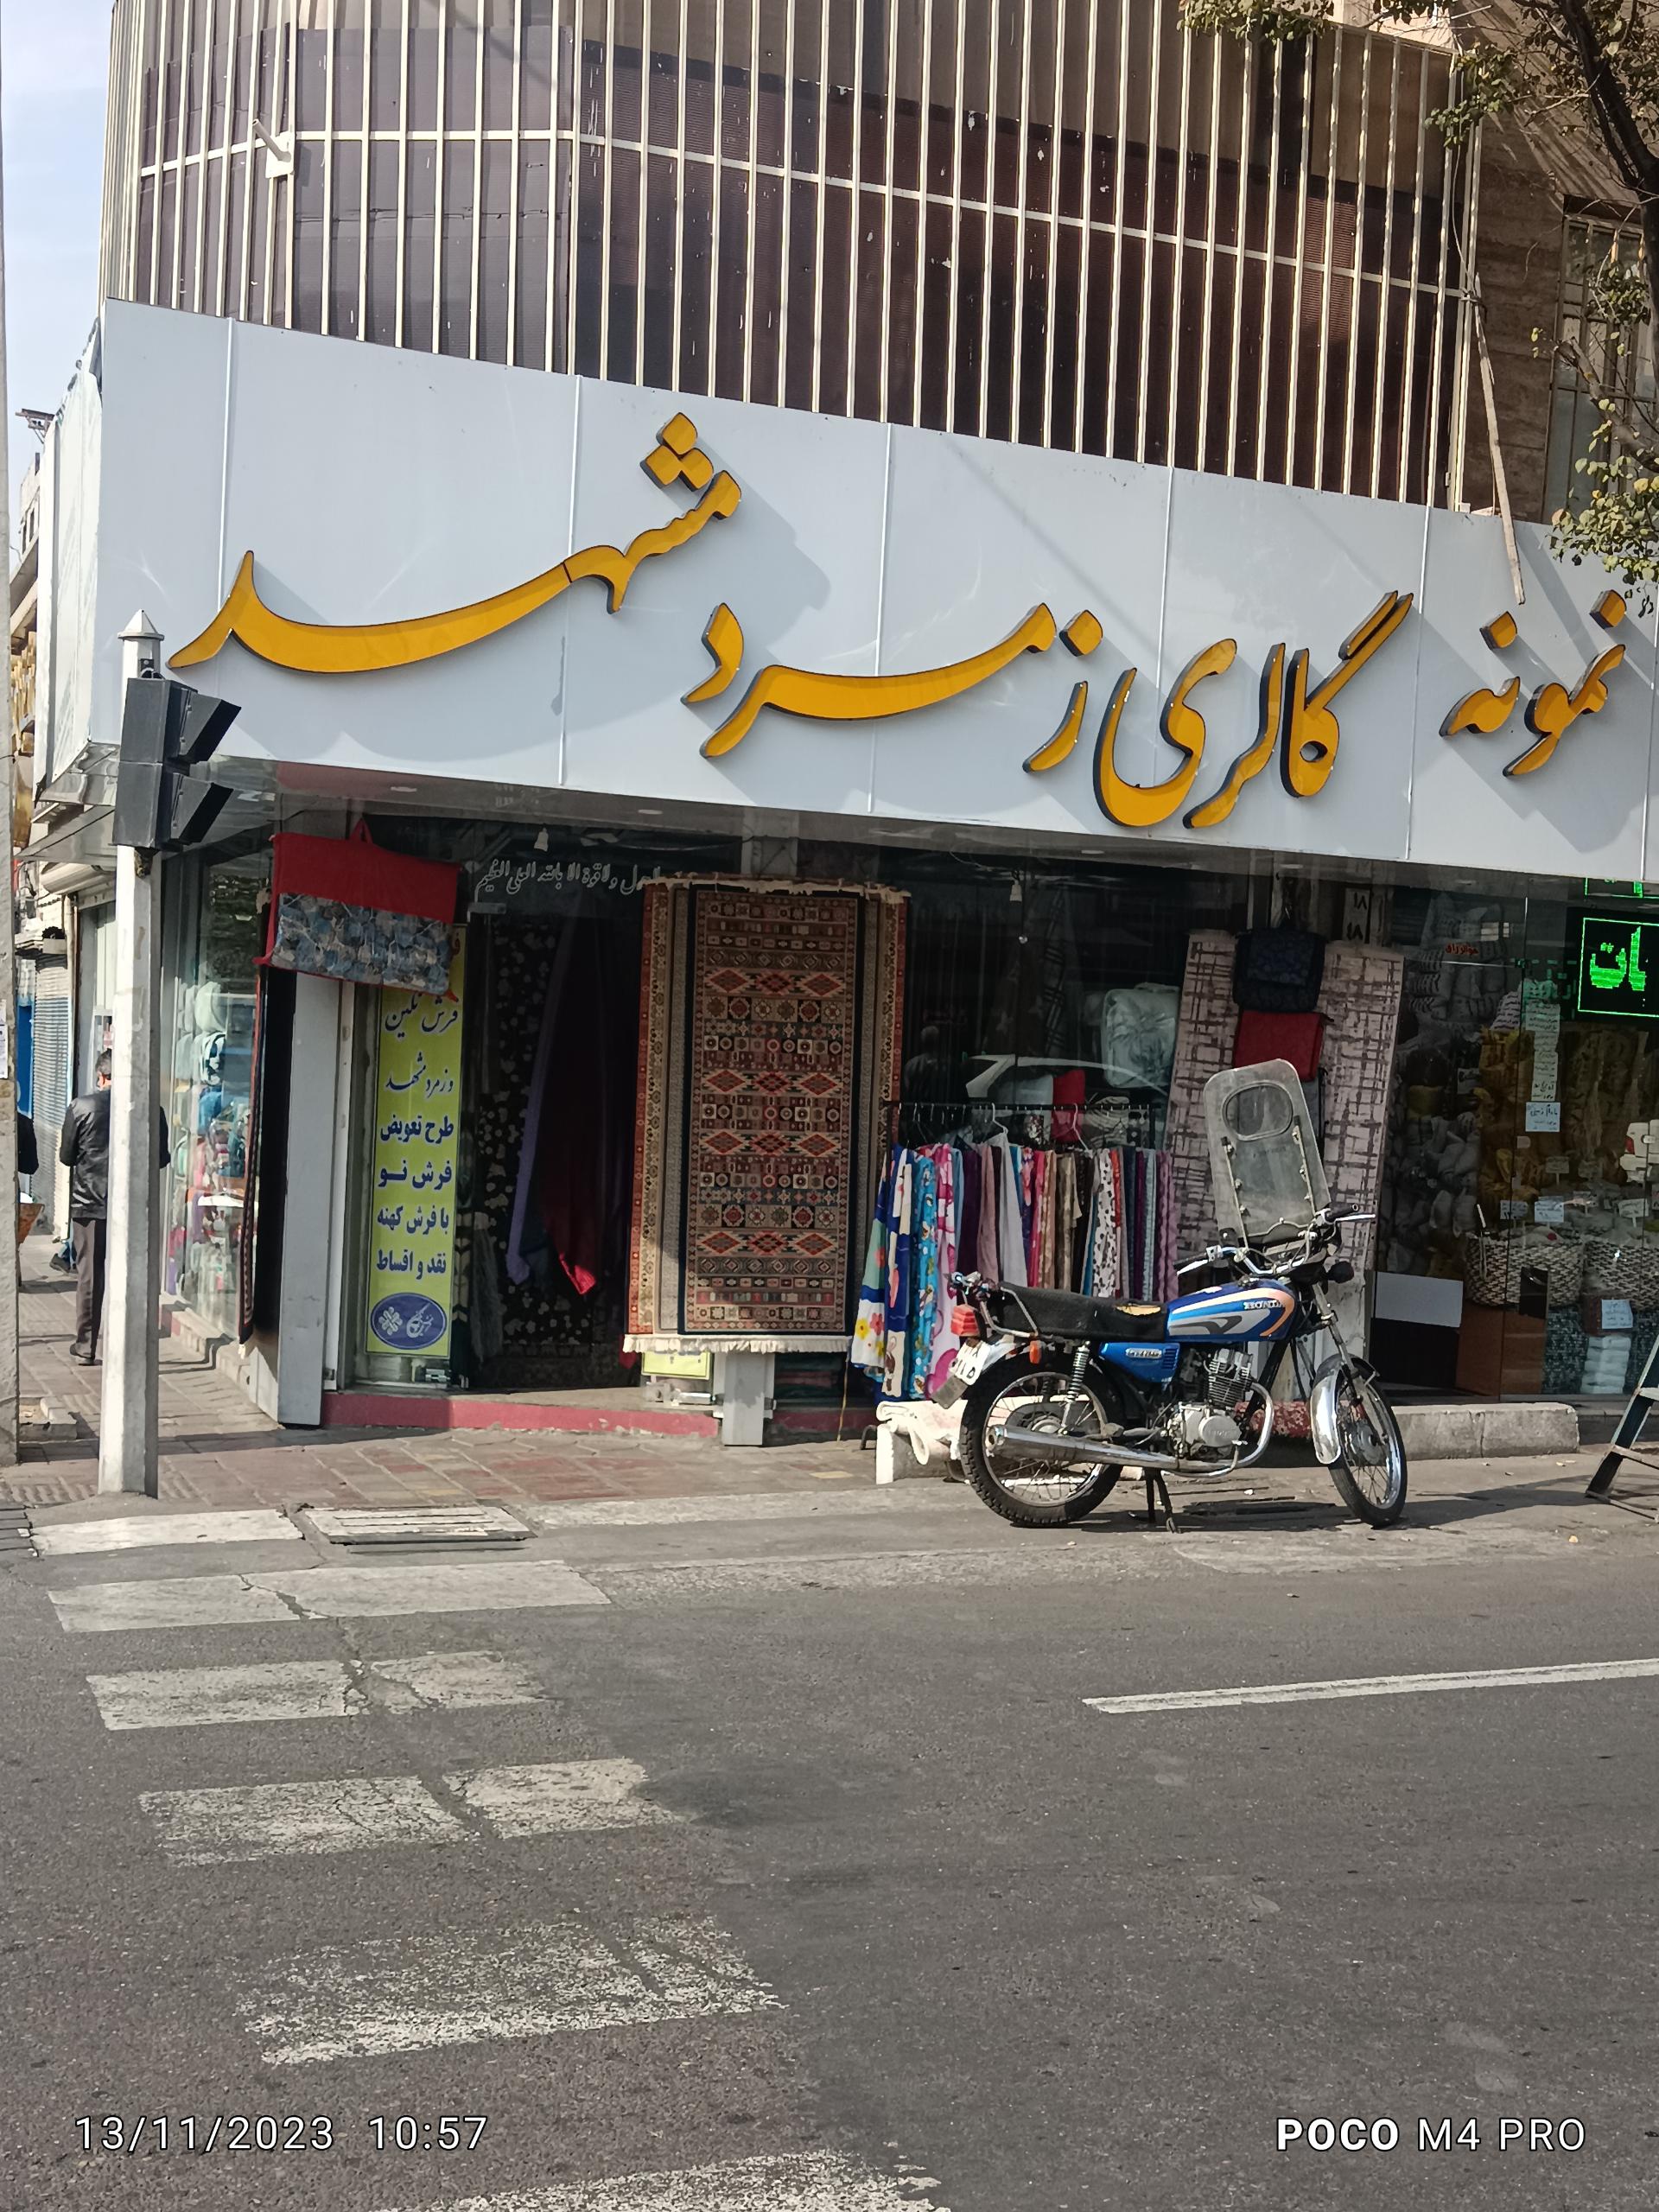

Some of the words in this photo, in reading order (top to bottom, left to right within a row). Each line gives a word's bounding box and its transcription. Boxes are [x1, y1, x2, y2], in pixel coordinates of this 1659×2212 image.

[165, 411, 742, 674] مشهد
[680, 602, 1103, 774] زمرد
[1092, 590, 1414, 830] گالری
[421, 994, 459, 1033] فرش
[380, 1114, 423, 1142] تعویض
[423, 1115, 454, 1144] طرح
[412, 1160, 452, 1191] فرش
[377, 1205, 404, 1231] کهنه
[406, 1205, 437, 1235] فرش
[440, 1207, 450, 1235] با
[376, 1249, 414, 1272] اقساط
[416, 1259, 423, 1280] و
[427, 1252, 447, 1274] نقد
[1243, 1299, 1285, 1310] HONDA
